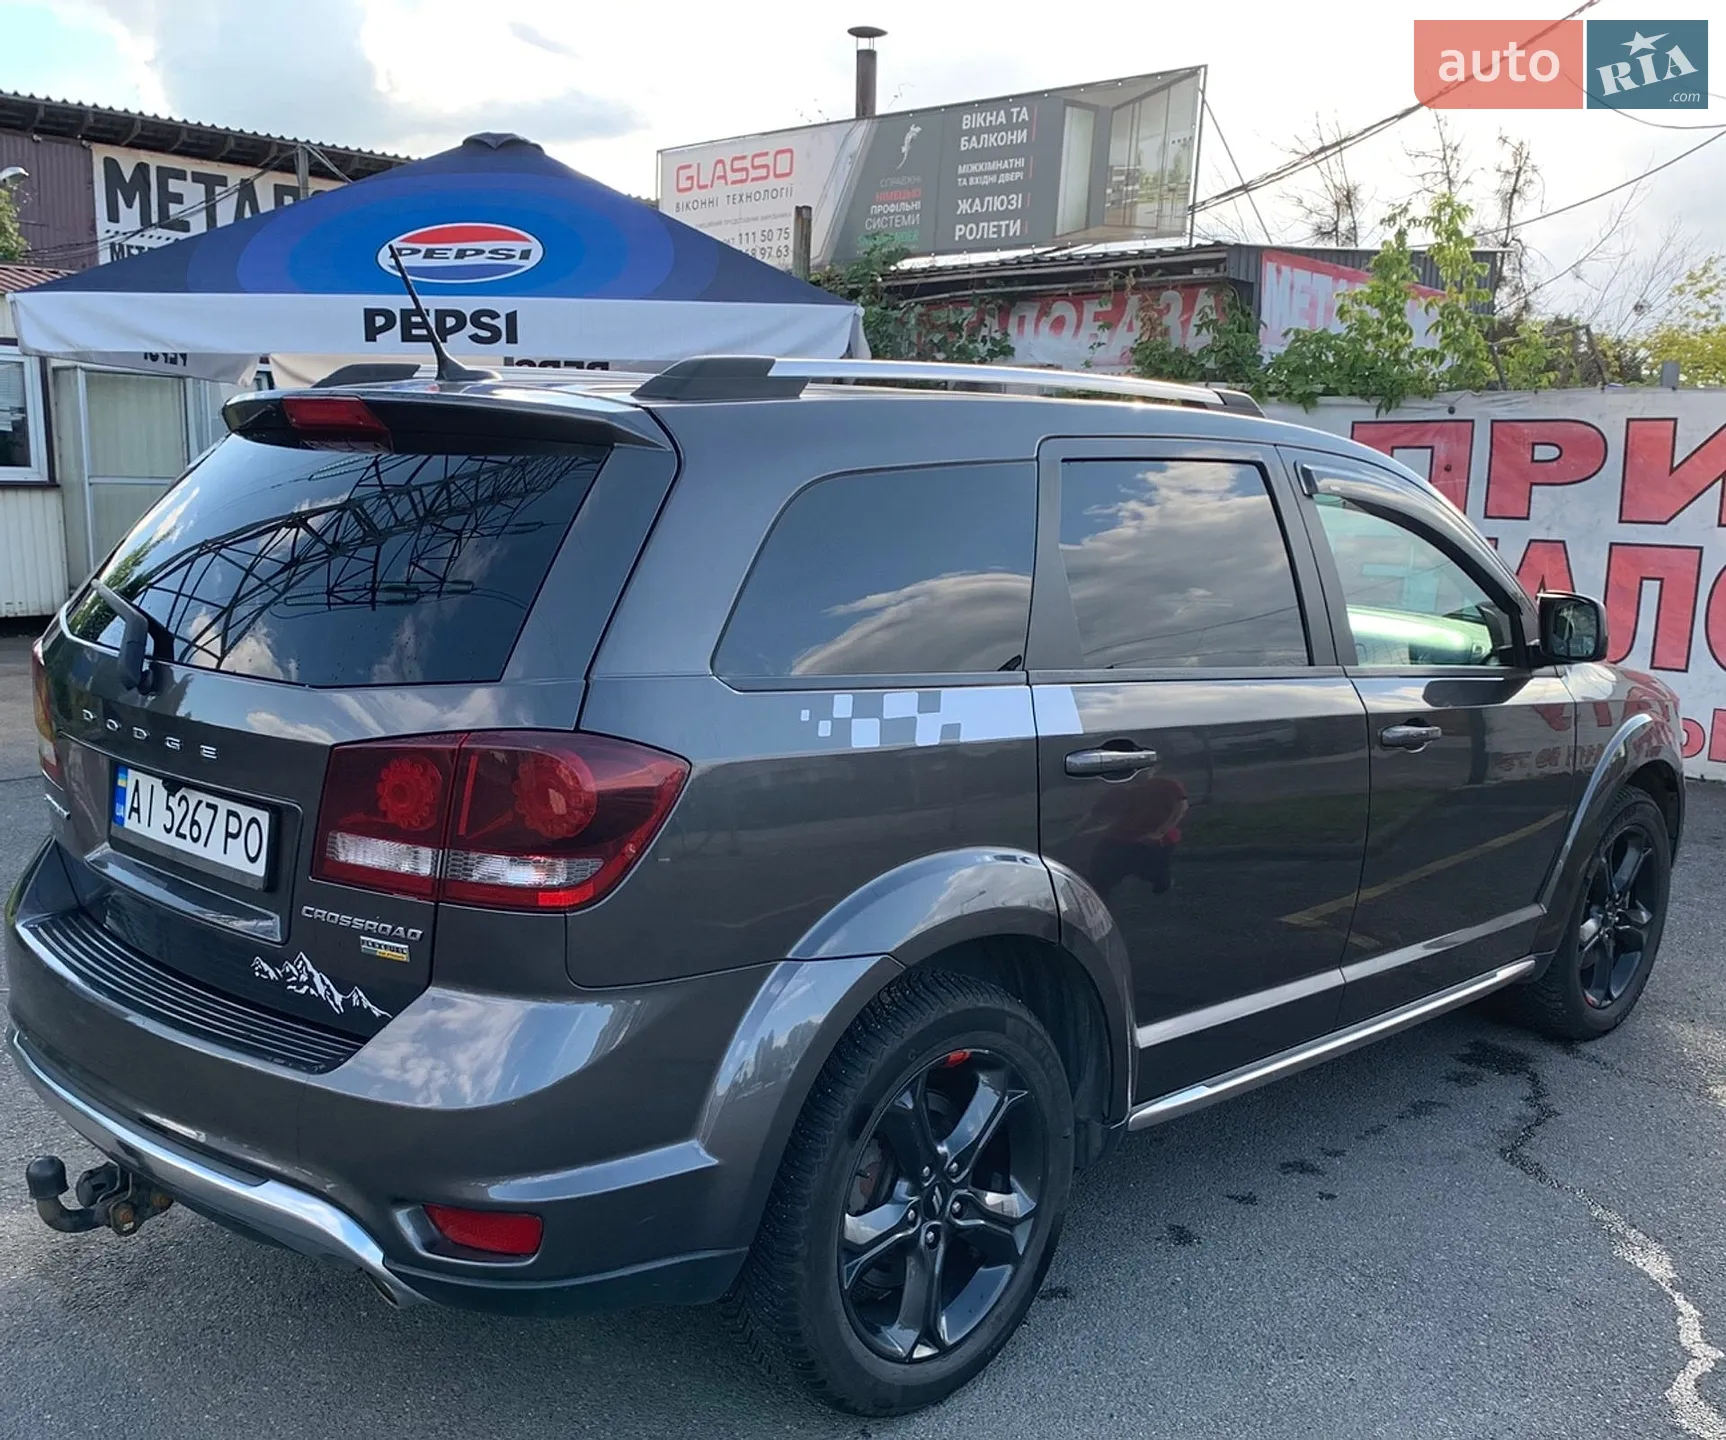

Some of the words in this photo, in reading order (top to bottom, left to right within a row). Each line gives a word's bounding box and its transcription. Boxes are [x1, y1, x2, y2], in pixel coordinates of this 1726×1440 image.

[962, 109, 1006, 130] ВІКНА
[1010, 106, 1029, 123] ТА
[960, 128, 1028, 151] БАЛКОНИ
[676, 148, 794, 193] GLASSO
[958, 157, 1025, 174] МІЖКІМНАТНІ
[998, 171, 1024, 184] ДВЕРІ
[675, 196, 719, 213] ВІКОННІ
[726, 184, 794, 206] ТЕХНОЛОГІЇ
[870, 200, 921, 215] ПРОФІЛЬНІ
[957, 193, 1022, 215] ЖАЛЮЗІ
[865, 213, 920, 230] СИСТЕМИ
[955, 218, 1021, 241] РОЛЕТИ
[738, 230, 757, 246] 111
[760, 228, 773, 243] 50
[777, 226, 790, 241] 75
[390, 247, 532, 261] PEPSI
[776, 244, 790, 258] 63
[363, 308, 518, 344] PEPSI
[82, 708, 218, 759] DODGE
[127, 779, 155, 827] AI
[162, 790, 219, 849] 5267
[222, 809, 264, 864] PO
[301, 905, 423, 941] CROSSROAD
